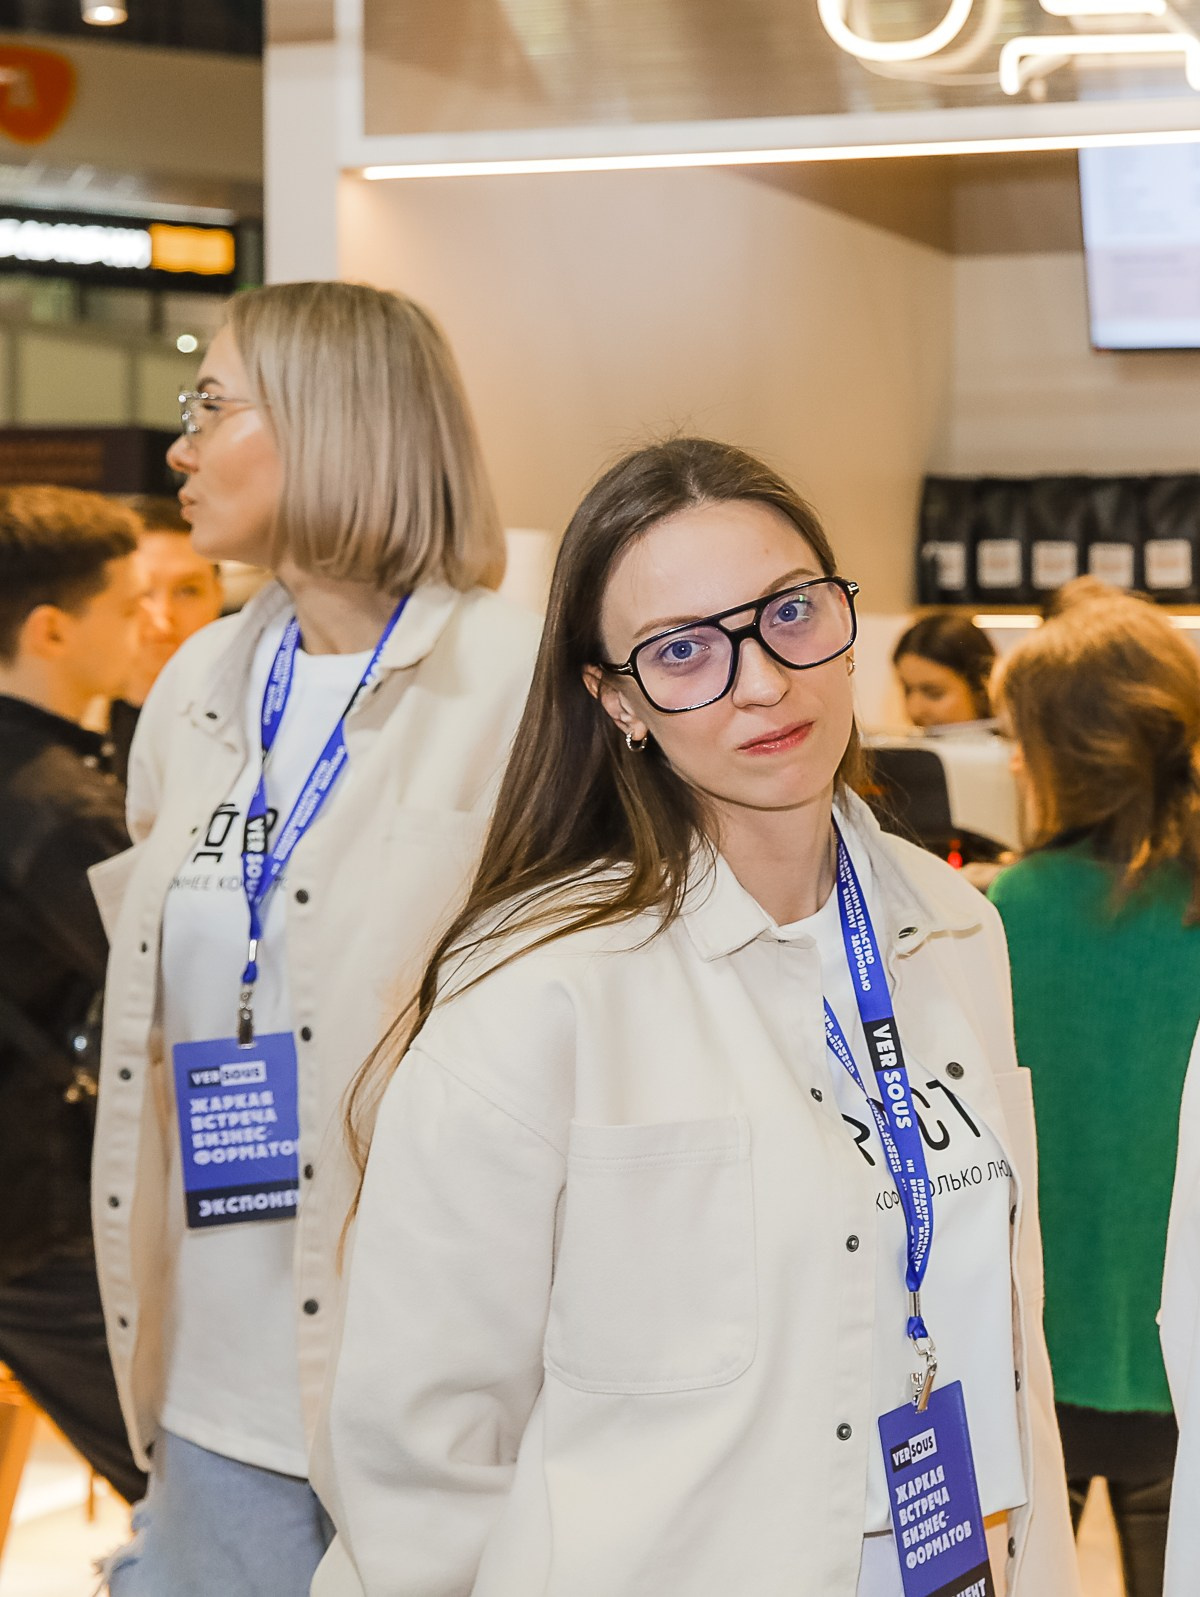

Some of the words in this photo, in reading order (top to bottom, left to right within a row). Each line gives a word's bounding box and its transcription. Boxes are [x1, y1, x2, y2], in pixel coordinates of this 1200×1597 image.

[842, 887, 858, 929] ВАШЕМУ
[851, 934, 871, 992] ЗДОРОВЬЮ
[190, 1090, 275, 1115] ЖАРКАЯ
[190, 1107, 278, 1132] ВСТРЕЧА
[895, 1465, 945, 1505] ЖАРКАЯ
[898, 1486, 950, 1527] ВСТРЕЧА
[901, 1510, 950, 1549] БИЗНЕС-
[906, 1520, 972, 1570] ФОРМАТОВ
